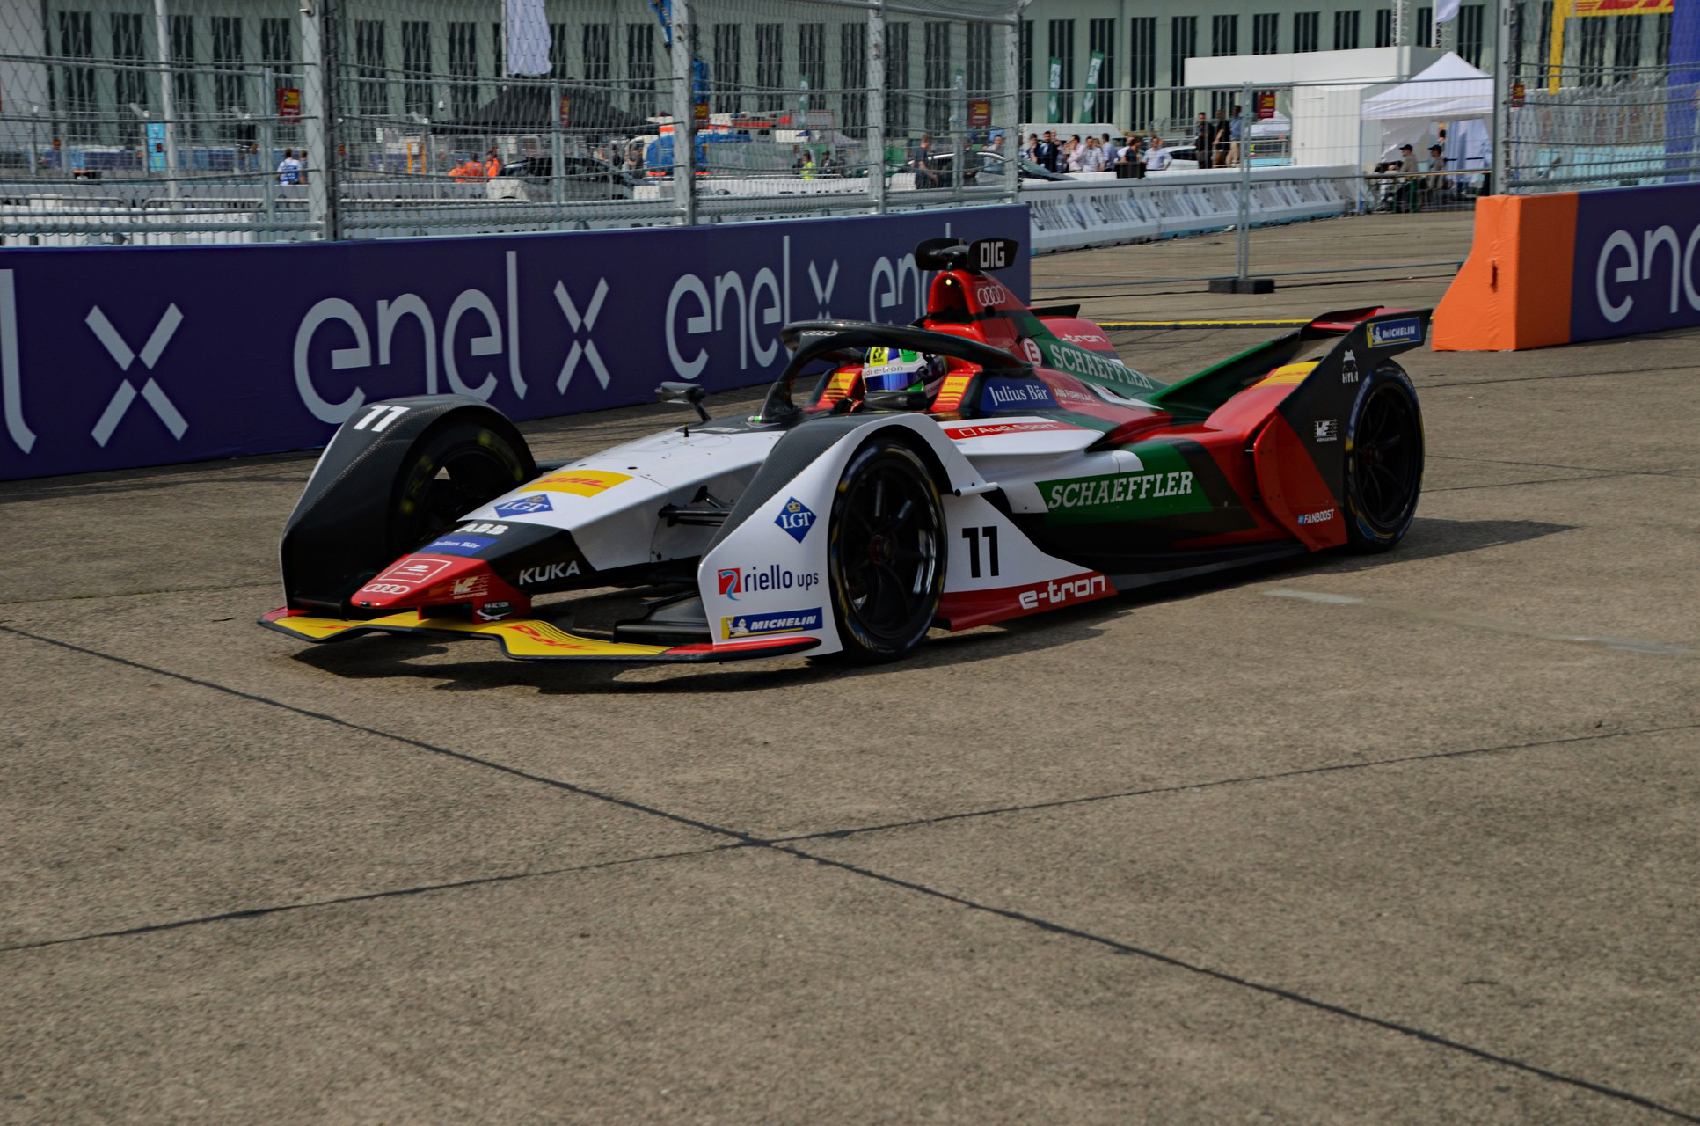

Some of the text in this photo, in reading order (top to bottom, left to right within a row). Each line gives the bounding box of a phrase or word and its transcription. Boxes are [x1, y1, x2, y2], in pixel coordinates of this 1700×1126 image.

[980, 241, 1005, 267] DIG
[666, 235, 795, 380] enel
[294, 251, 610, 424] enel x
[1382, 325, 1416, 339] MICHELIN
[84, 302, 189, 448] x
[1050, 344, 1154, 389] SCHAEFFLER
[988, 383, 1049, 406] Julius Bär
[354, 405, 410, 432] 11
[980, 420, 1058, 435] Audi Sport
[1047, 471, 1195, 509] SCHAEFFLER
[498, 501, 549, 512] LGT
[1303, 508, 1335, 524] FANBOOST
[454, 523, 509, 535] ABB
[780, 511, 811, 529] LGT
[962, 525, 999, 578] 11
[518, 560, 581, 585] KUKA
[744, 564, 819, 592] riello ups
[1018, 574, 1106, 610] e-tron
[750, 615, 817, 631] MICHELIN
